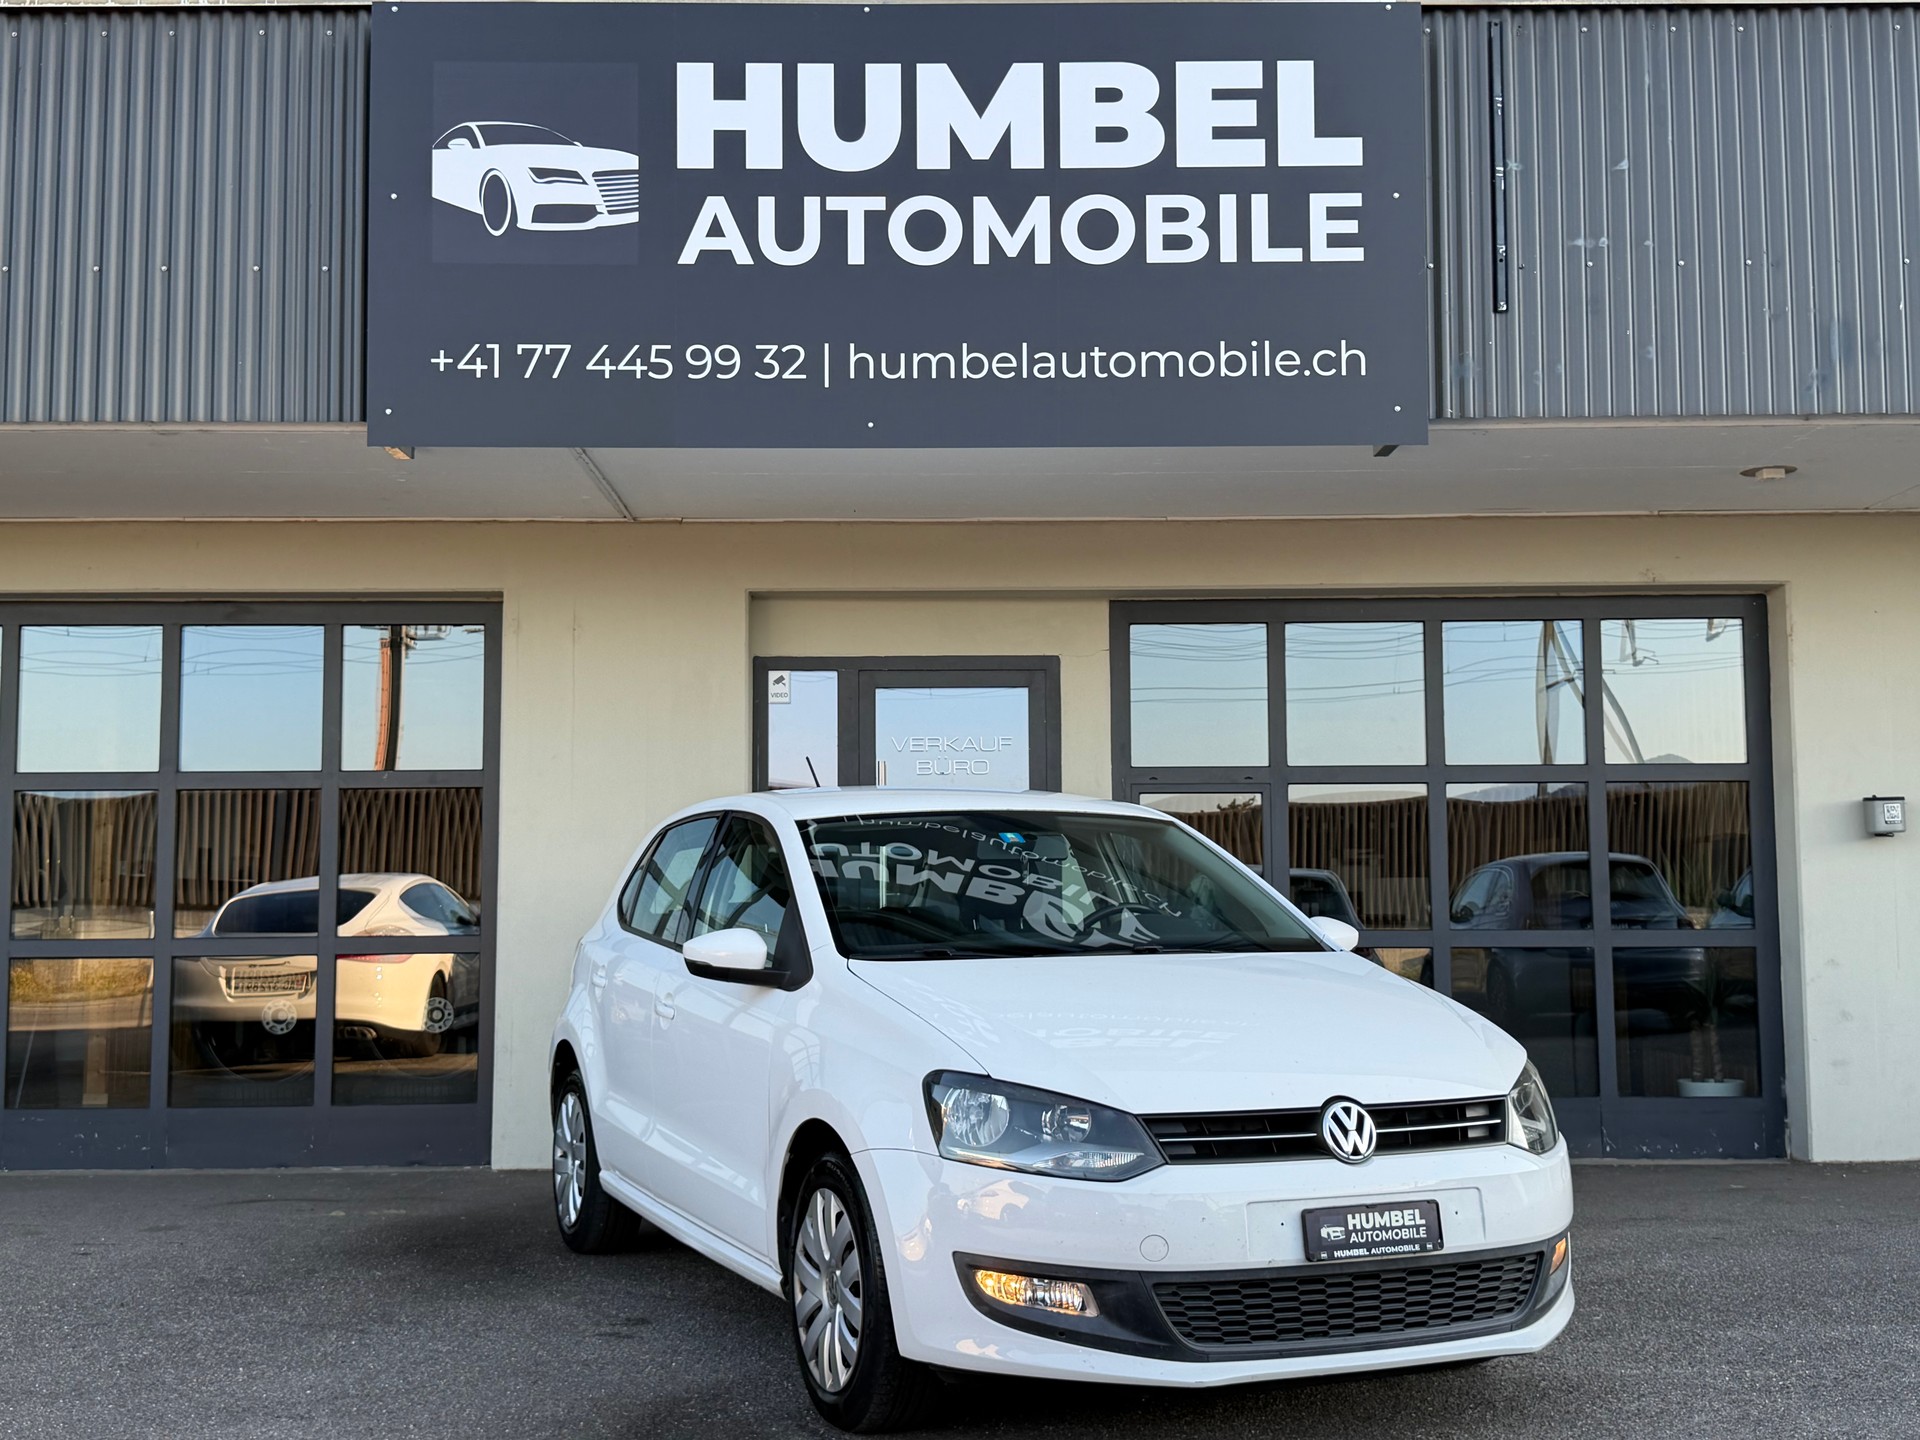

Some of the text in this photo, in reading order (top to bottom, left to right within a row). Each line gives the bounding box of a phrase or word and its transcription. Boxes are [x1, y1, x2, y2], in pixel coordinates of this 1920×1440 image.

[676, 60, 1364, 173] HUMBEL
[677, 192, 1365, 266] AUTOMOBILE
[430, 343, 500, 380] +41
[516, 343, 572, 380] 77
[585, 343, 674, 380] 445
[685, 343, 741, 381] 99
[754, 343, 807, 380] 32
[848, 339, 1367, 380] humbelautomobile.ch
[891, 736, 1013, 752] VERKAUF
[916, 756, 990, 775] BÜRO
[1347, 1209, 1425, 1230] HUMBEL
[1350, 1227, 1427, 1243] AUTOMOBILE
[1334, 1244, 1420, 1258] HUMBEL AUTOMOBILE
